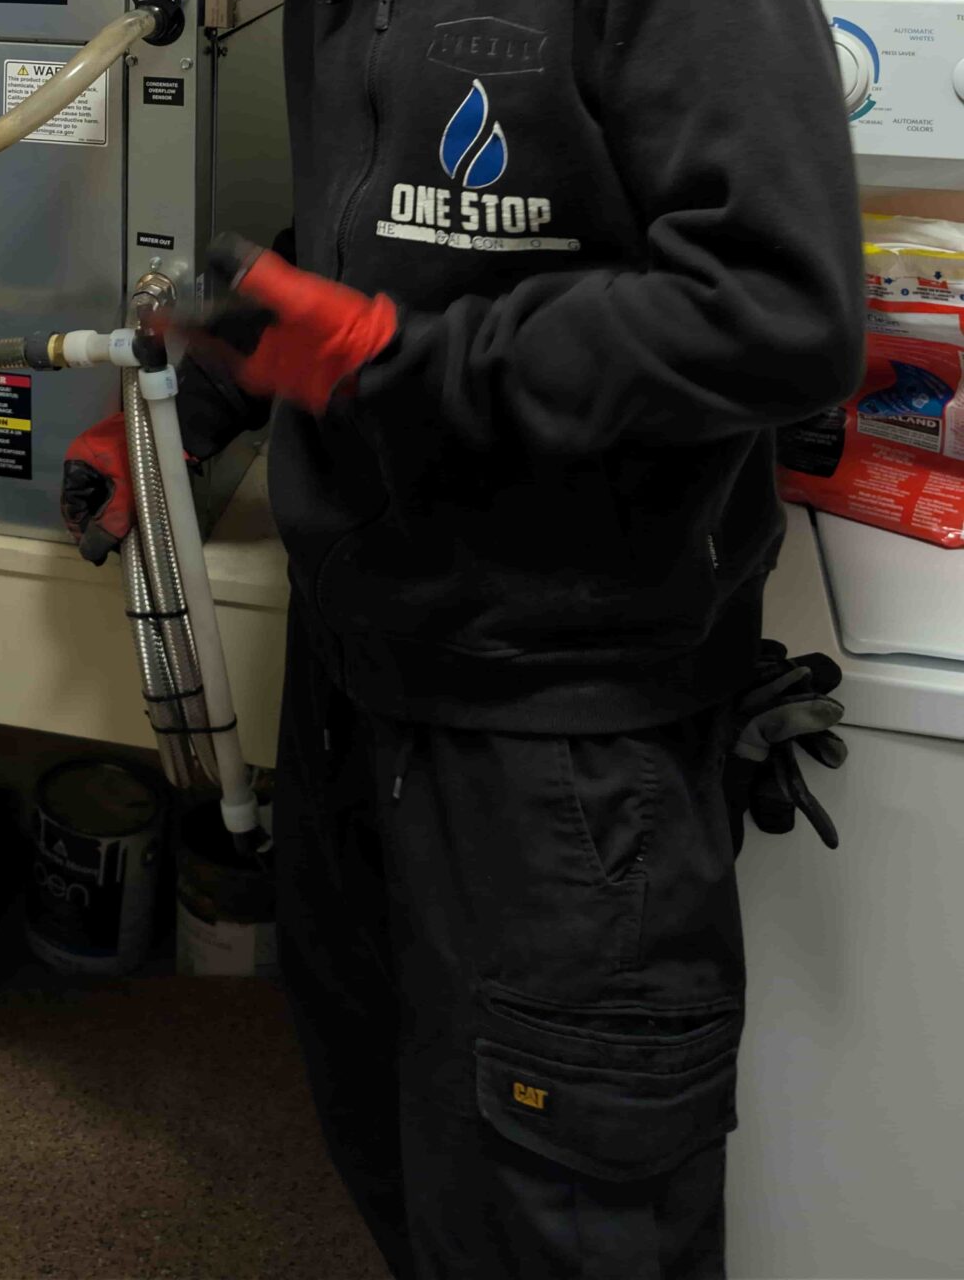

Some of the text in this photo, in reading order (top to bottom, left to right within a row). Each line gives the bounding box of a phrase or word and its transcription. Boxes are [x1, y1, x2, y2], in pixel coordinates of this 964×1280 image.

[391, 183, 451, 228] ONE
[461, 191, 551, 233] STOP
[513, 1082, 548, 1109] CAT
